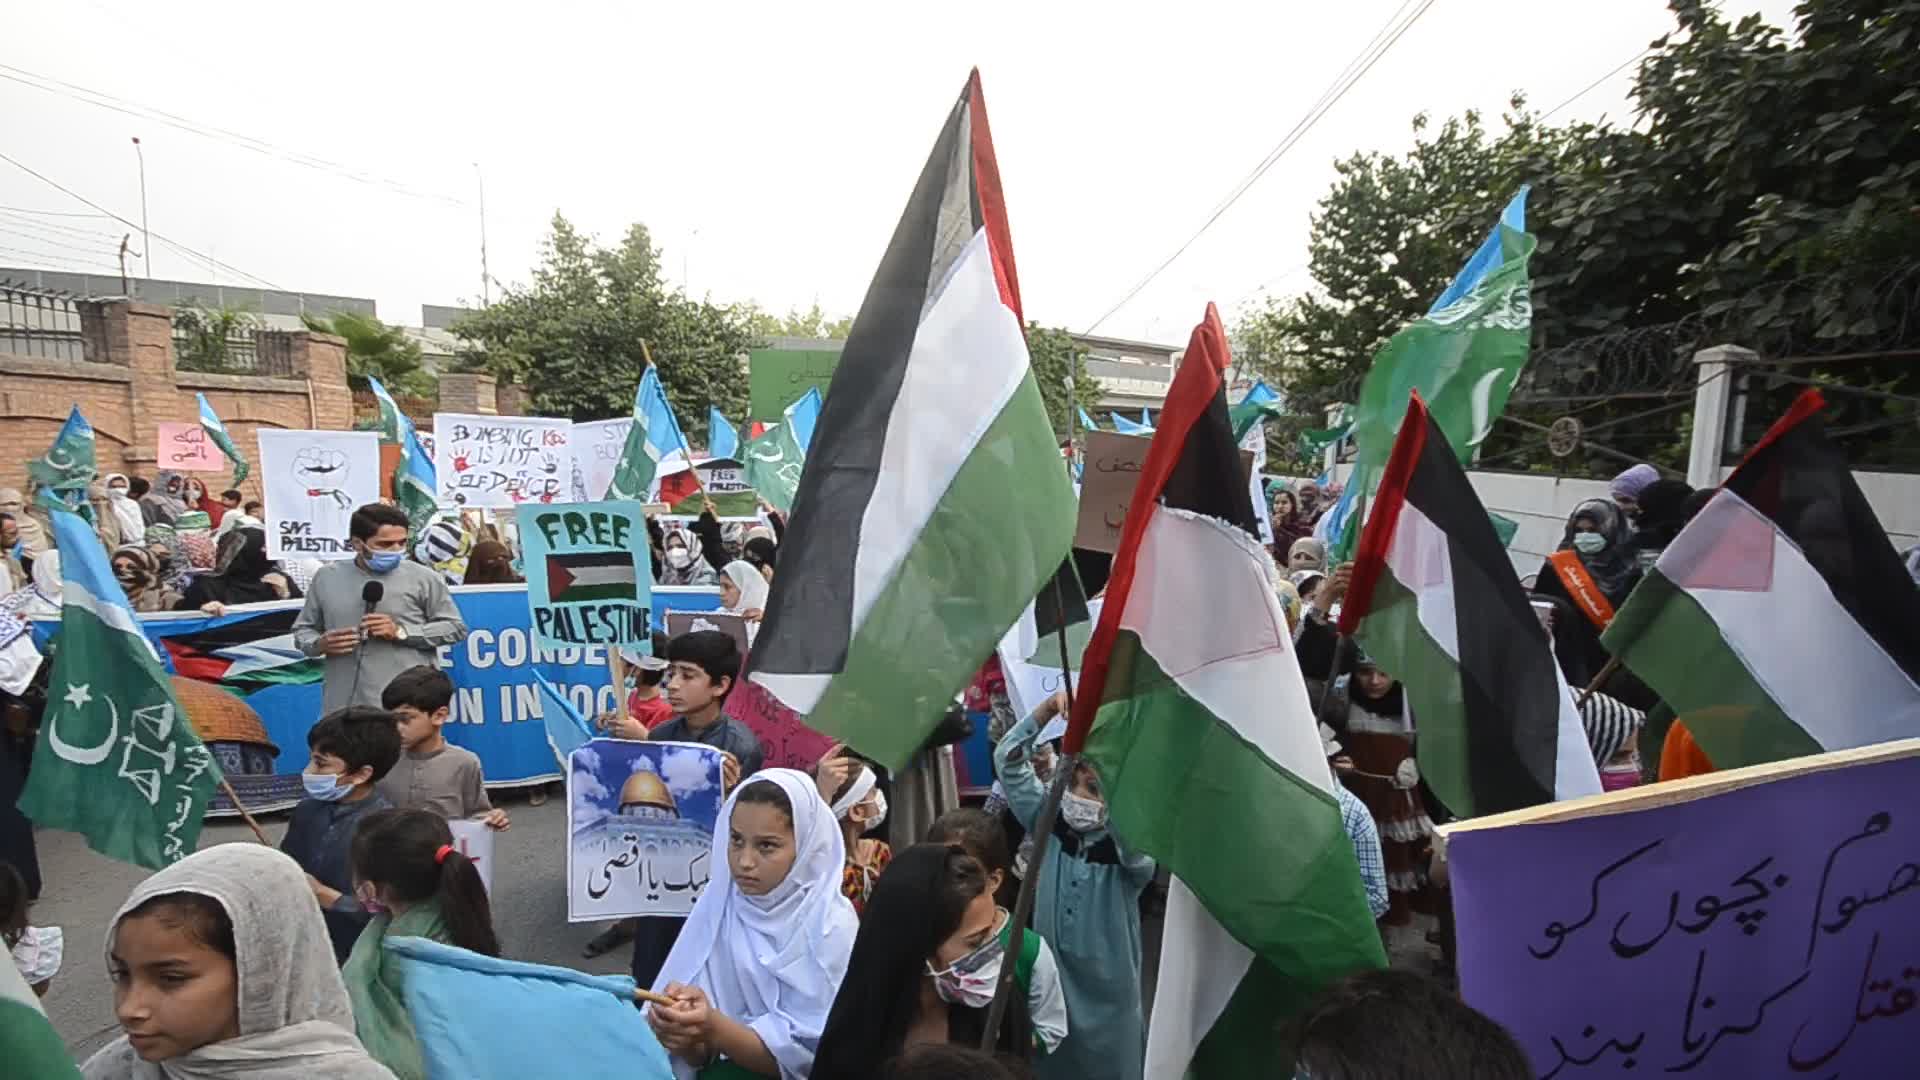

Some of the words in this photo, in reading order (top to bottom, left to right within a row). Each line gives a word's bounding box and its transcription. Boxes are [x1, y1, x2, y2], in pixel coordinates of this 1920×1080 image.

[279, 521, 311, 535] SAVE
[281, 537, 353, 552] PALESTINE
[535, 511, 631, 550] FREE
[534, 604, 650, 644] PALESTINE
[1528, 838, 1663, 960] کو
[1609, 856, 1789, 957] بچوں
